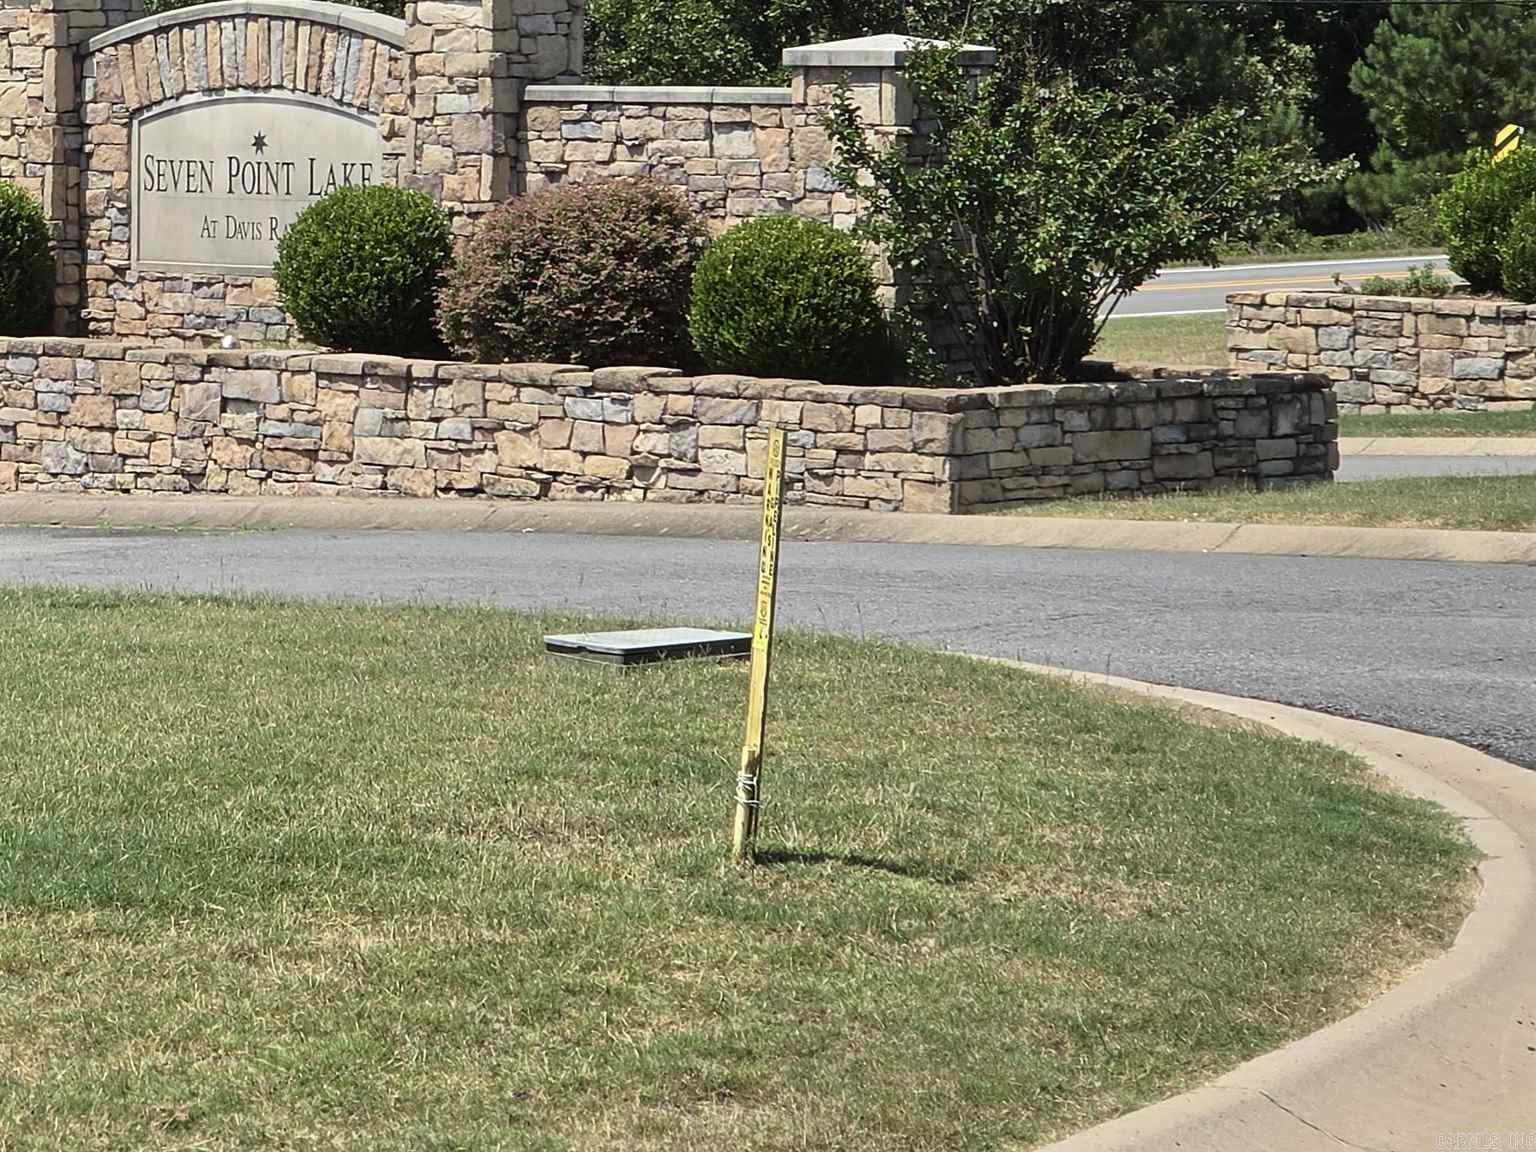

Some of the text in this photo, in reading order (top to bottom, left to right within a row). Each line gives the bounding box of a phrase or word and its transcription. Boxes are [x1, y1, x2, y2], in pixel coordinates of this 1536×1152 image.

[144, 154, 214, 193] SEVEN
[227, 156, 295, 195] POINT
[200, 215, 218, 239] AT
[225, 215, 262, 240] DAVIS
